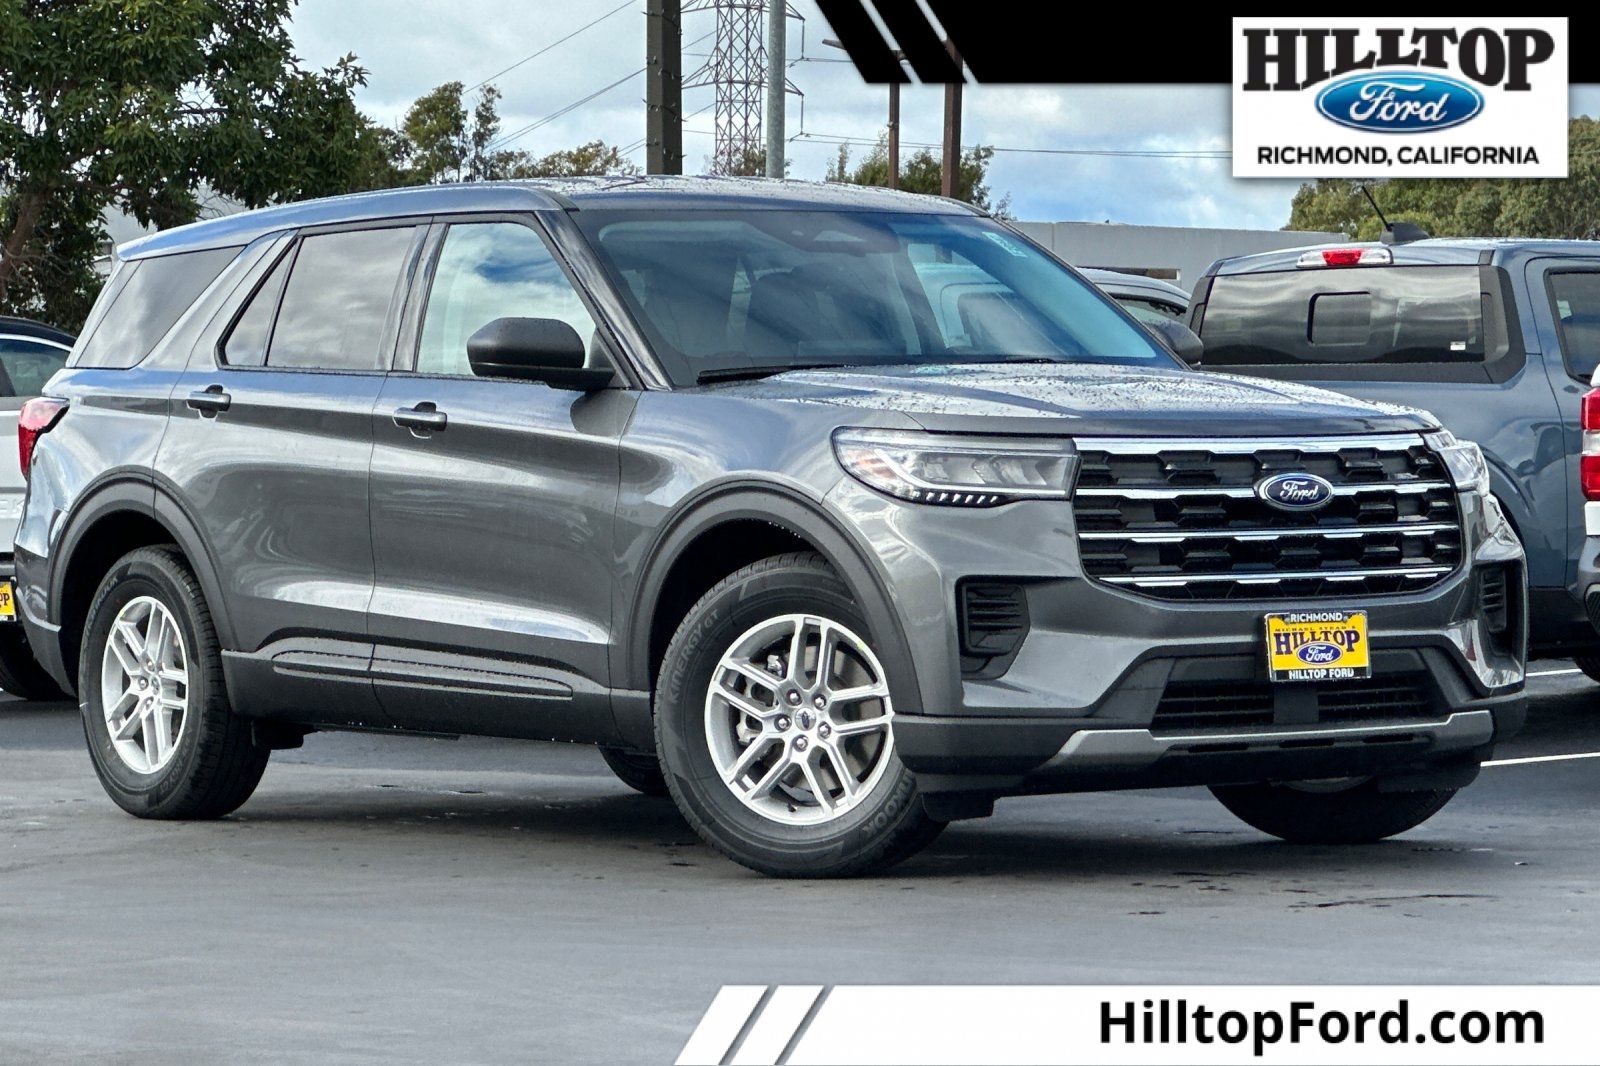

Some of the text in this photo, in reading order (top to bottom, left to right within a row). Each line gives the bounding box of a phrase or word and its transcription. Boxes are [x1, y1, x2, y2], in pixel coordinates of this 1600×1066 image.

[1279, 480, 1318, 500] Ford
[1290, 612, 1343, 622] RICHMOND
[1274, 629, 1360, 655] HILLTOP
[1305, 645, 1334, 662] Ford
[1288, 667, 1355, 680] HILLTOP FORD
